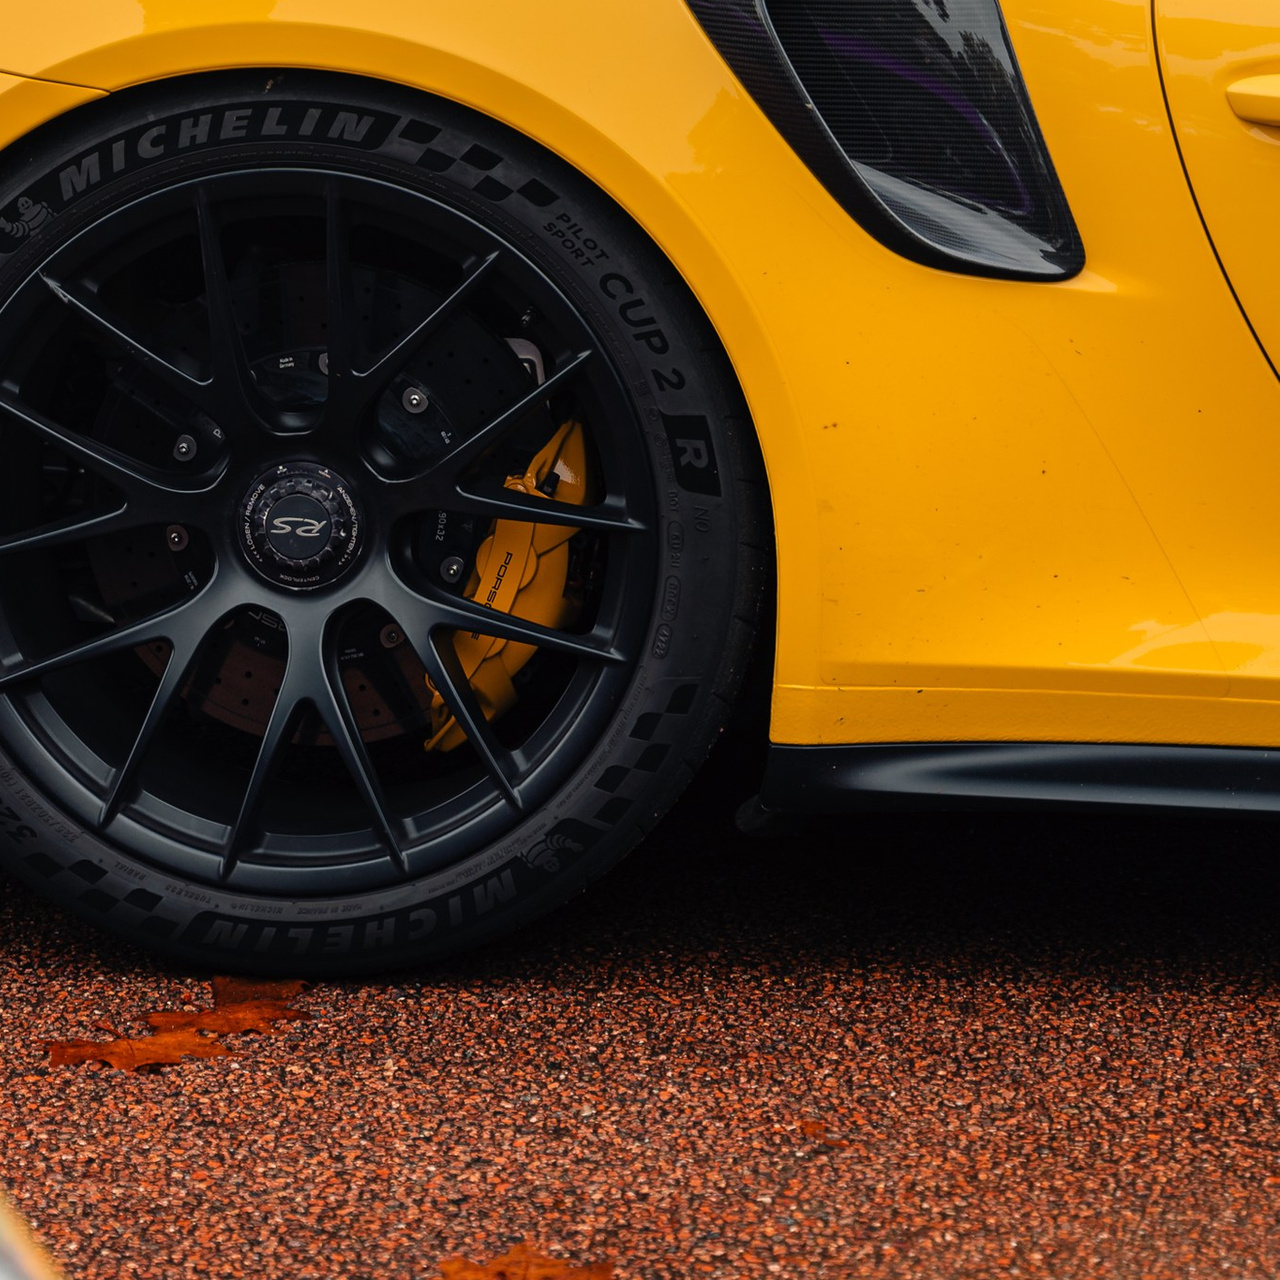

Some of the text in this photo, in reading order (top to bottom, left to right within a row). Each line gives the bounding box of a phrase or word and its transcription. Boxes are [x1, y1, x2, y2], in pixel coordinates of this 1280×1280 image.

[57, 107, 376, 201] MICHELIN
[543, 221, 594, 267] SPORT
[555, 212, 610, 261] PILOT
[598, 271, 670, 356] CUP
[651, 361, 686, 393] 2
[676, 436, 709, 467] R
[270, 516, 328, 537] RS
[434, 510, 448, 542] 90x32
[202, 868, 519, 952] MICHELIN
